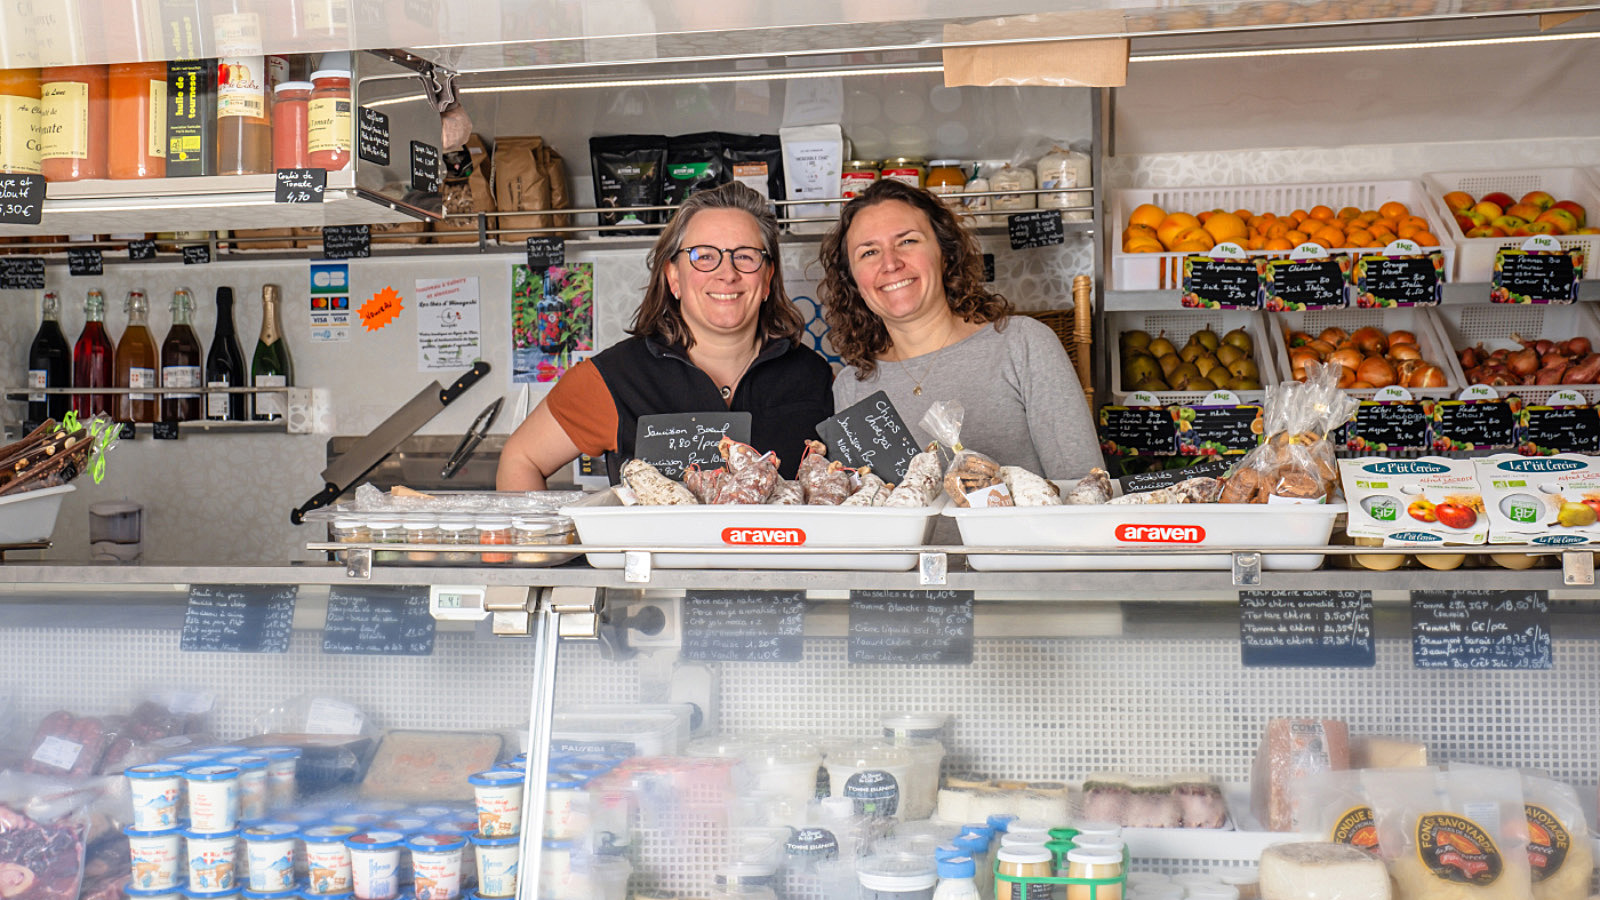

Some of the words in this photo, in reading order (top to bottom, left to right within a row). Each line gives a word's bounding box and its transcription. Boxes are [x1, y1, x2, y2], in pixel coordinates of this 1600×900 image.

[175, 76, 184, 89] de
[187, 71, 197, 119] tournesol
[175, 91, 184, 116] huile
[282, 180, 312, 188] Tomate
[287, 191, 310, 203] 4,70
[1396, 242, 1413, 251] 1kg
[1534, 238, 1551, 247] 1kg
[1220, 245, 1237, 254] 1kg
[1301, 246, 1318, 254] 1kg
[314, 271, 345, 287] CB
[1135, 393, 1151, 402] 1kg
[1386, 388, 1403, 397] 1kg
[1559, 393, 1576, 401] 1kg
[876, 400, 900, 434] Chips
[643, 425, 688, 438] Saucisson
[1375, 463, 1386, 473] Le
[1387, 462, 1408, 473] P'tit
[1410, 462, 1441, 473] Cercier
[1508, 461, 1521, 470] Le
[1522, 460, 1545, 471] P'tit
[1546, 460, 1578, 470] Cercier
[730, 529, 799, 543] araven
[1124, 526, 1198, 541] araven
[854, 602, 884, 610] Tomme
[1416, 601, 1445, 609] Tomme
[1283, 610, 1312, 619] chèvre
[1244, 623, 1276, 632] Tomme
[1278, 623, 1288, 632] de
[1245, 635, 1281, 646] Raclette
[1418, 659, 1448, 668] Tomme
[1525, 807, 1567, 849] AVOYARDE
